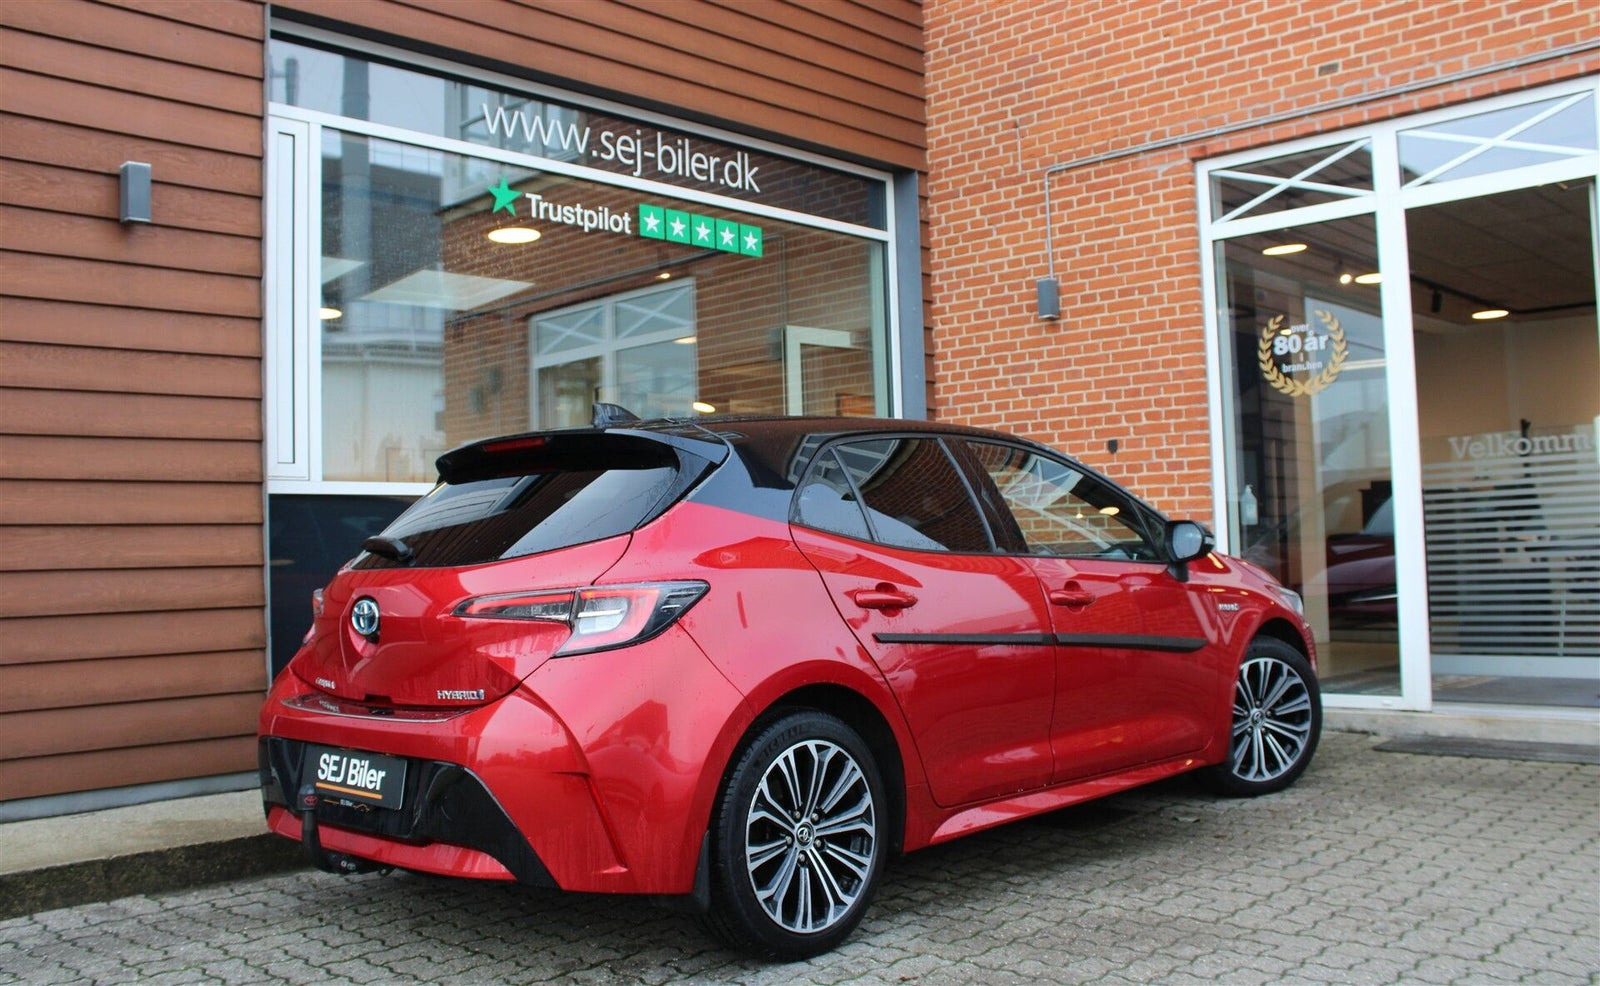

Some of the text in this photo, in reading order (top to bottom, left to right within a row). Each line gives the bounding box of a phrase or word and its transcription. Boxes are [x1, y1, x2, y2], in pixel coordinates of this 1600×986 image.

[482, 102, 761, 193] www.sej-biler.dk
[525, 192, 633, 234] Trustpilot
[1273, 330, 1329, 356] 80 år
[437, 690, 478, 700] HYBRID
[317, 753, 386, 790] SEJ Biler
